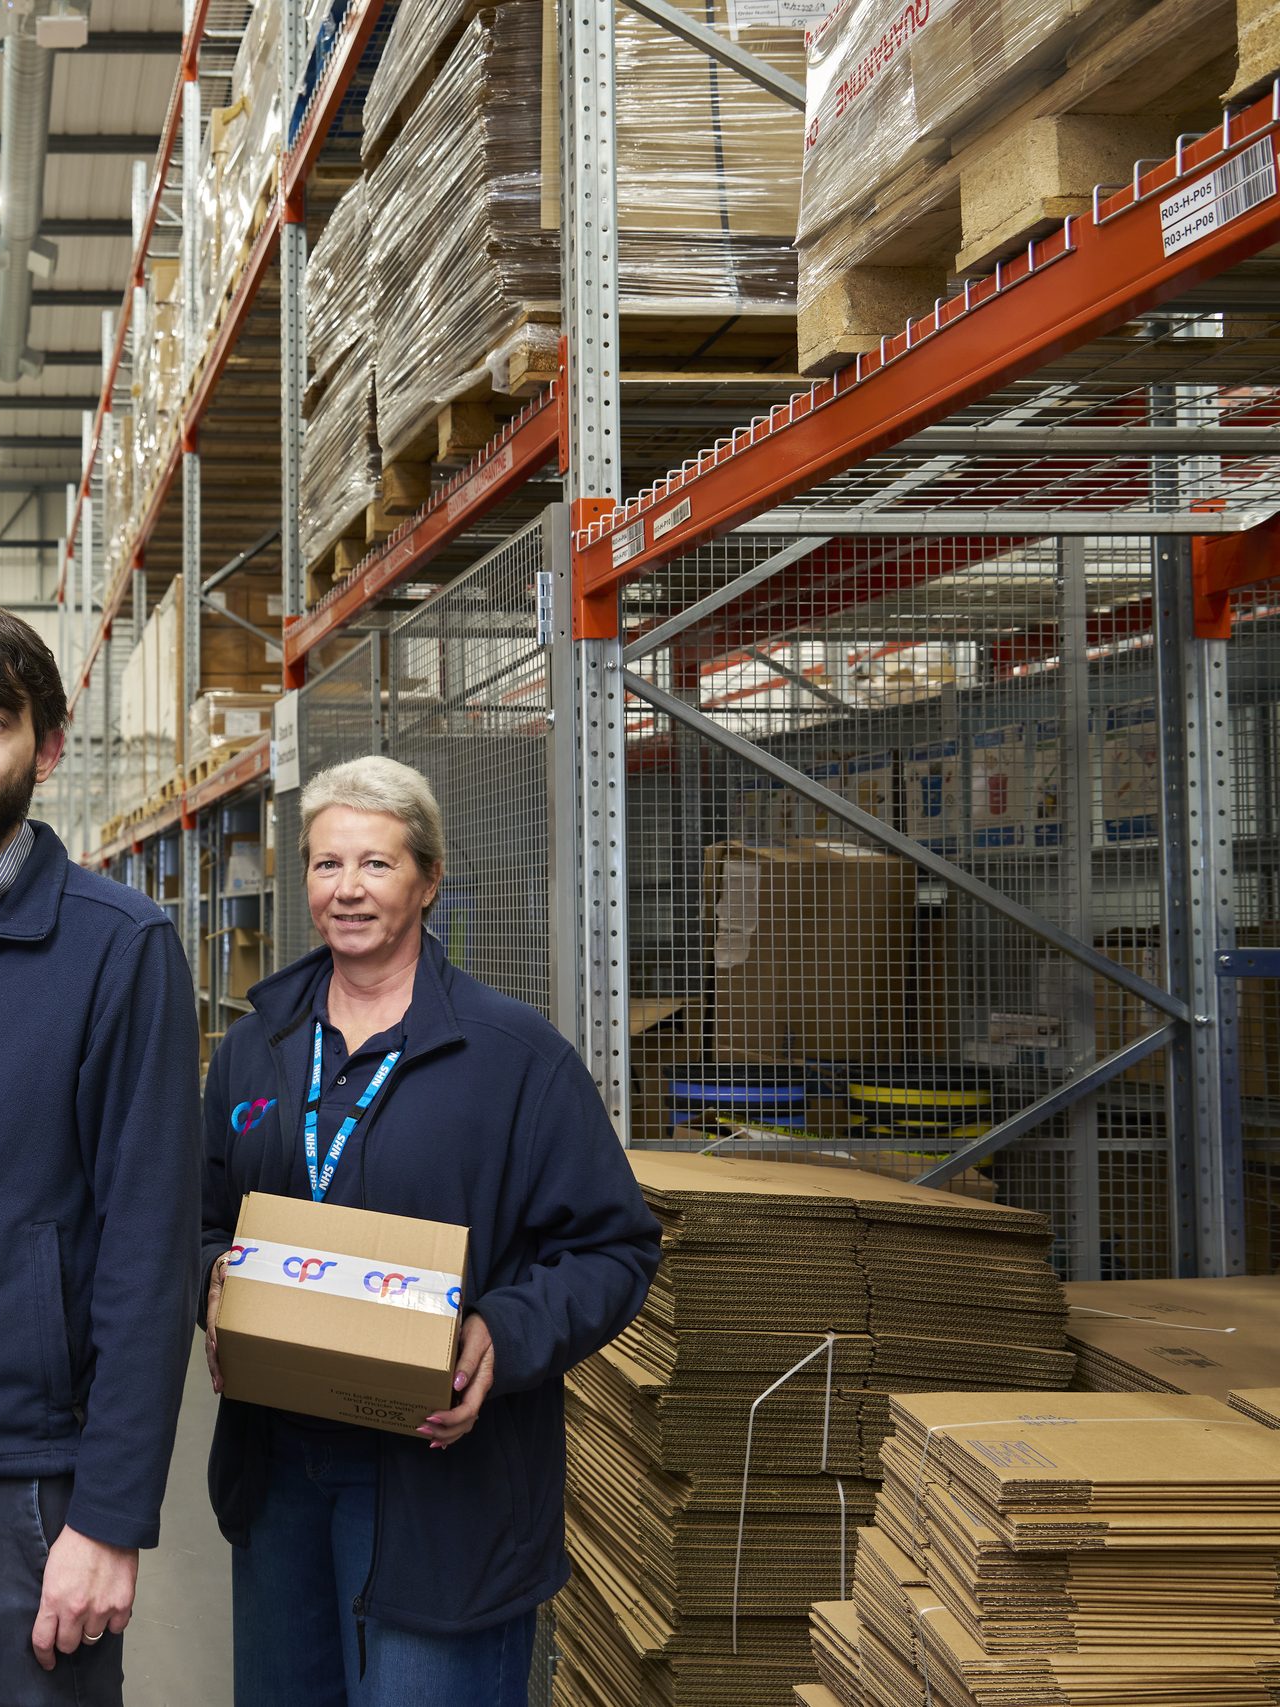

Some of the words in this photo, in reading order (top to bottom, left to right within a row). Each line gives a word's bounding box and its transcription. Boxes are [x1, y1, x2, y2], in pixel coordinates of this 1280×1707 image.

[1161, 182, 1212, 220] R03-H-P05
[1164, 212, 1214, 248] R03-H-P08
[313, 1064, 321, 1085] NHS
[371, 1065, 389, 1088] NHS
[306, 1133, 315, 1157] NHS
[329, 1132, 346, 1160] NHS
[319, 1164, 334, 1191] NHS
[354, 1405, 406, 1422] 100%
